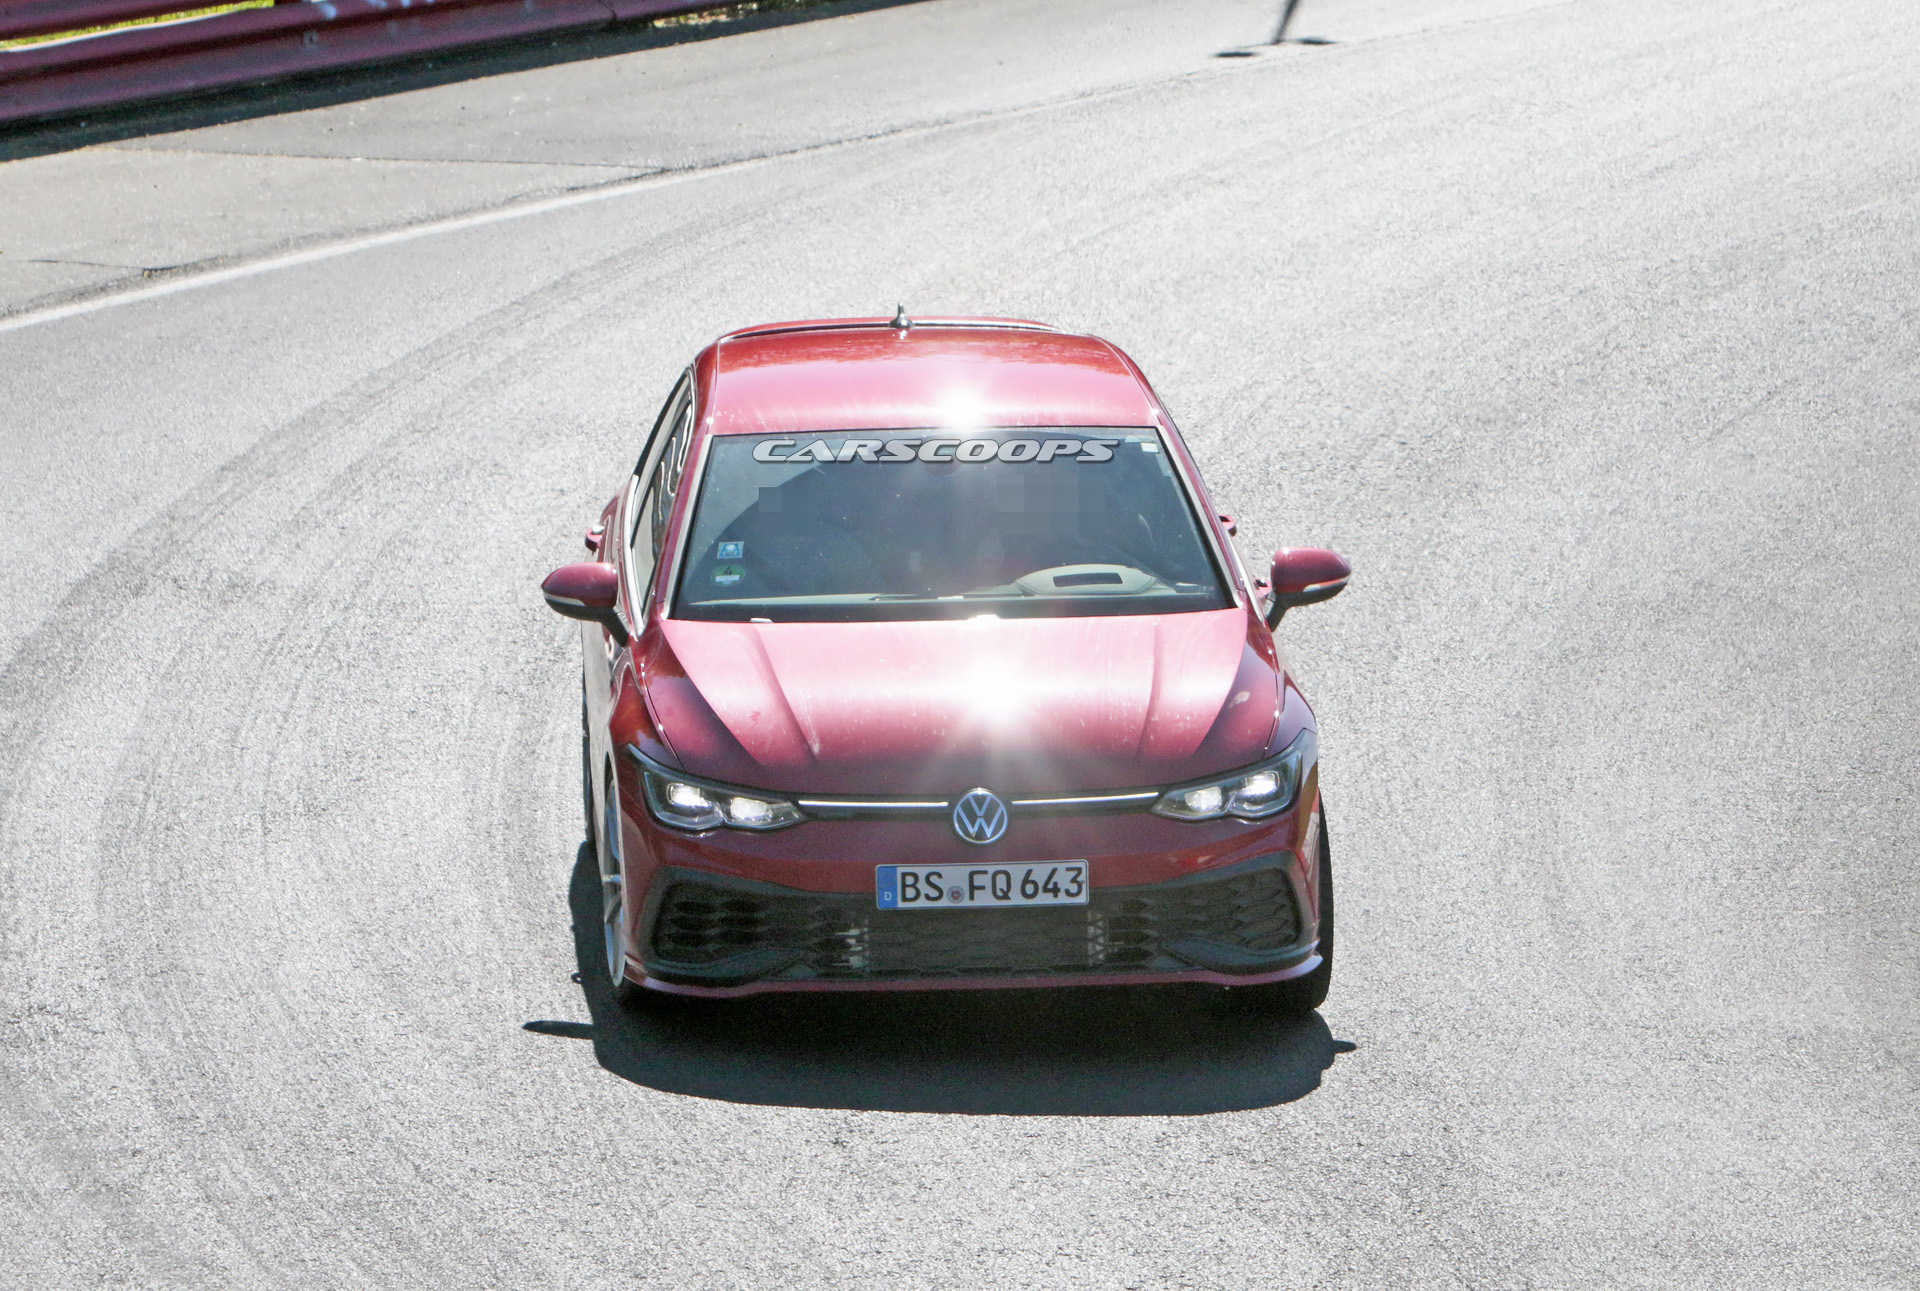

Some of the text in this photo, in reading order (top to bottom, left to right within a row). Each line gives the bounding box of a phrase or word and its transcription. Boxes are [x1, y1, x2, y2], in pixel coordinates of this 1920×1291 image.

[884, 866, 1084, 903] D BS FQ 643
